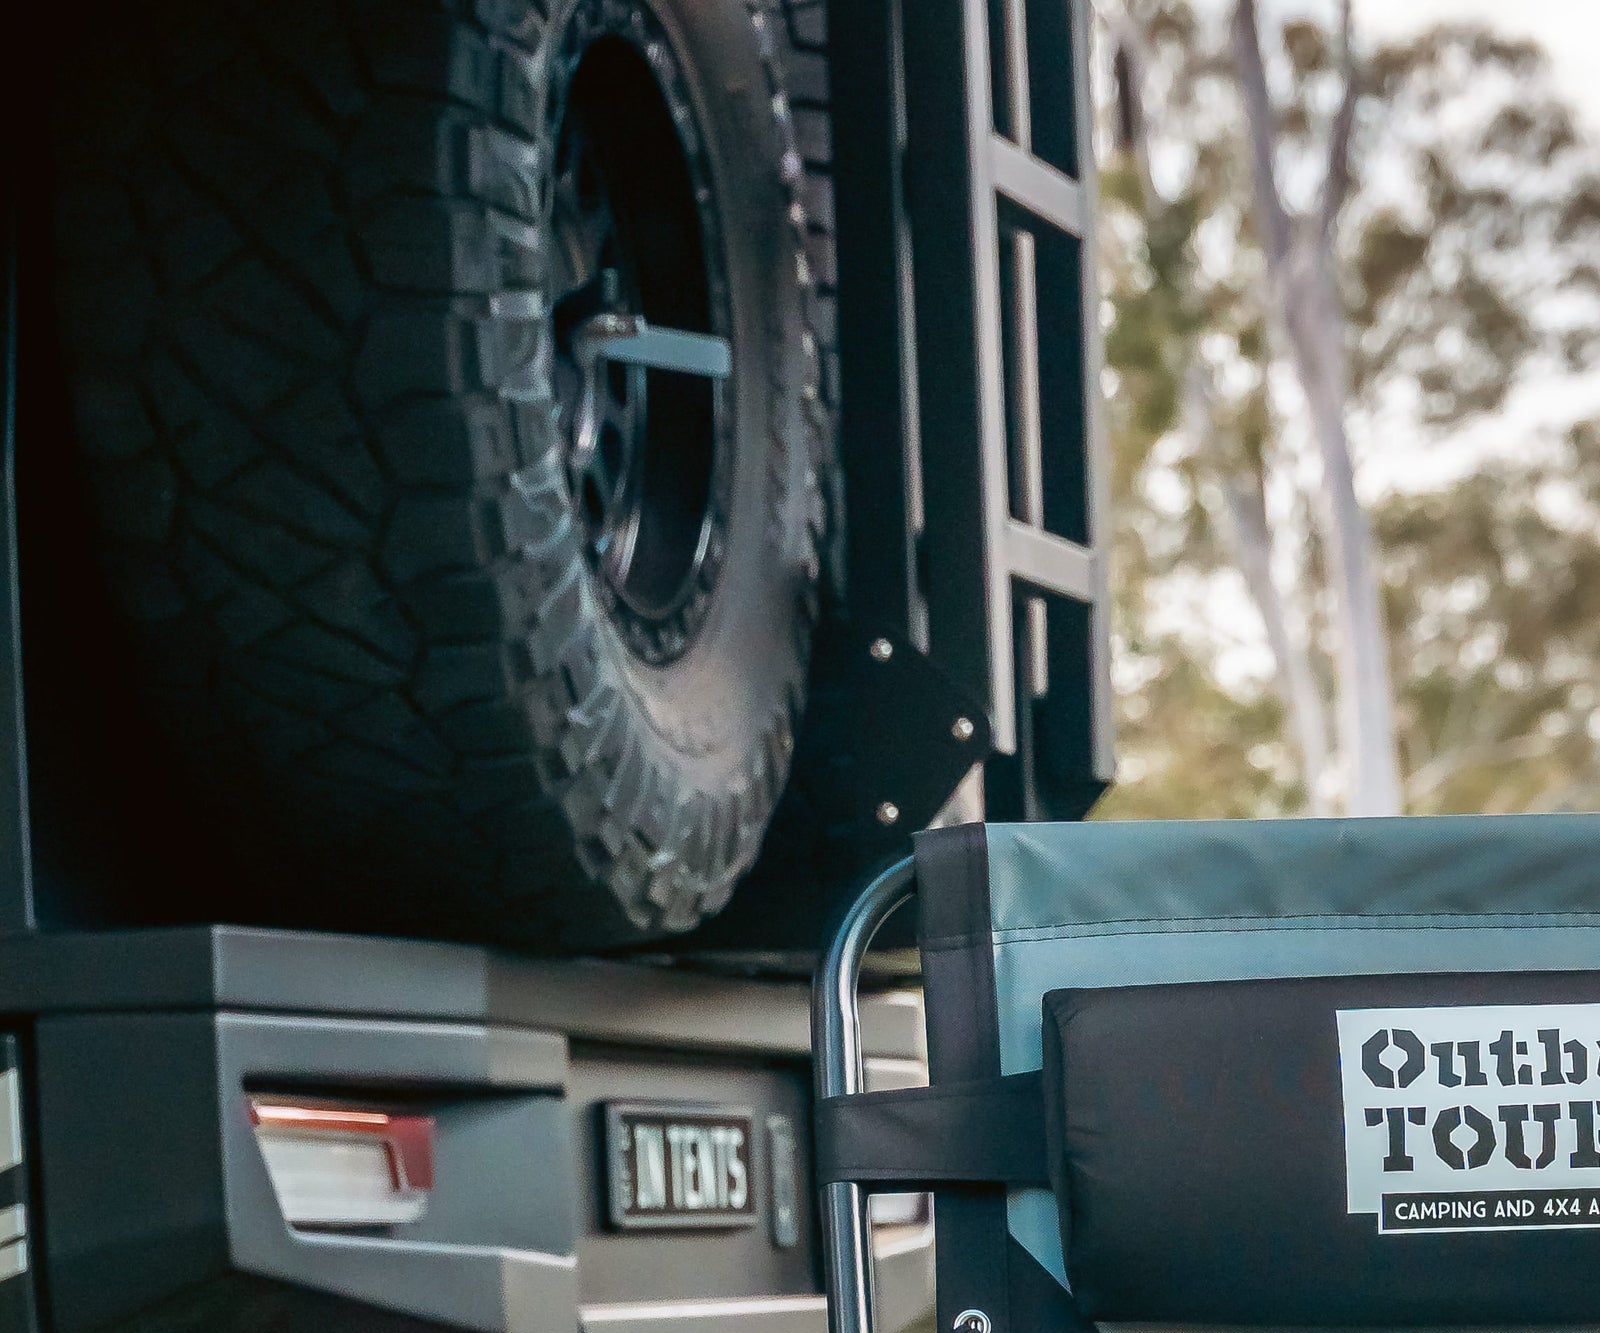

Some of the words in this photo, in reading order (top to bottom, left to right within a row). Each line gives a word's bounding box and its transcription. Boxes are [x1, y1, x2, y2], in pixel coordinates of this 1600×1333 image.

[1394, 1200, 1487, 1220] CAMPING
[1494, 1199, 1536, 1218] AND
[1543, 1197, 1581, 1217] 4X4
